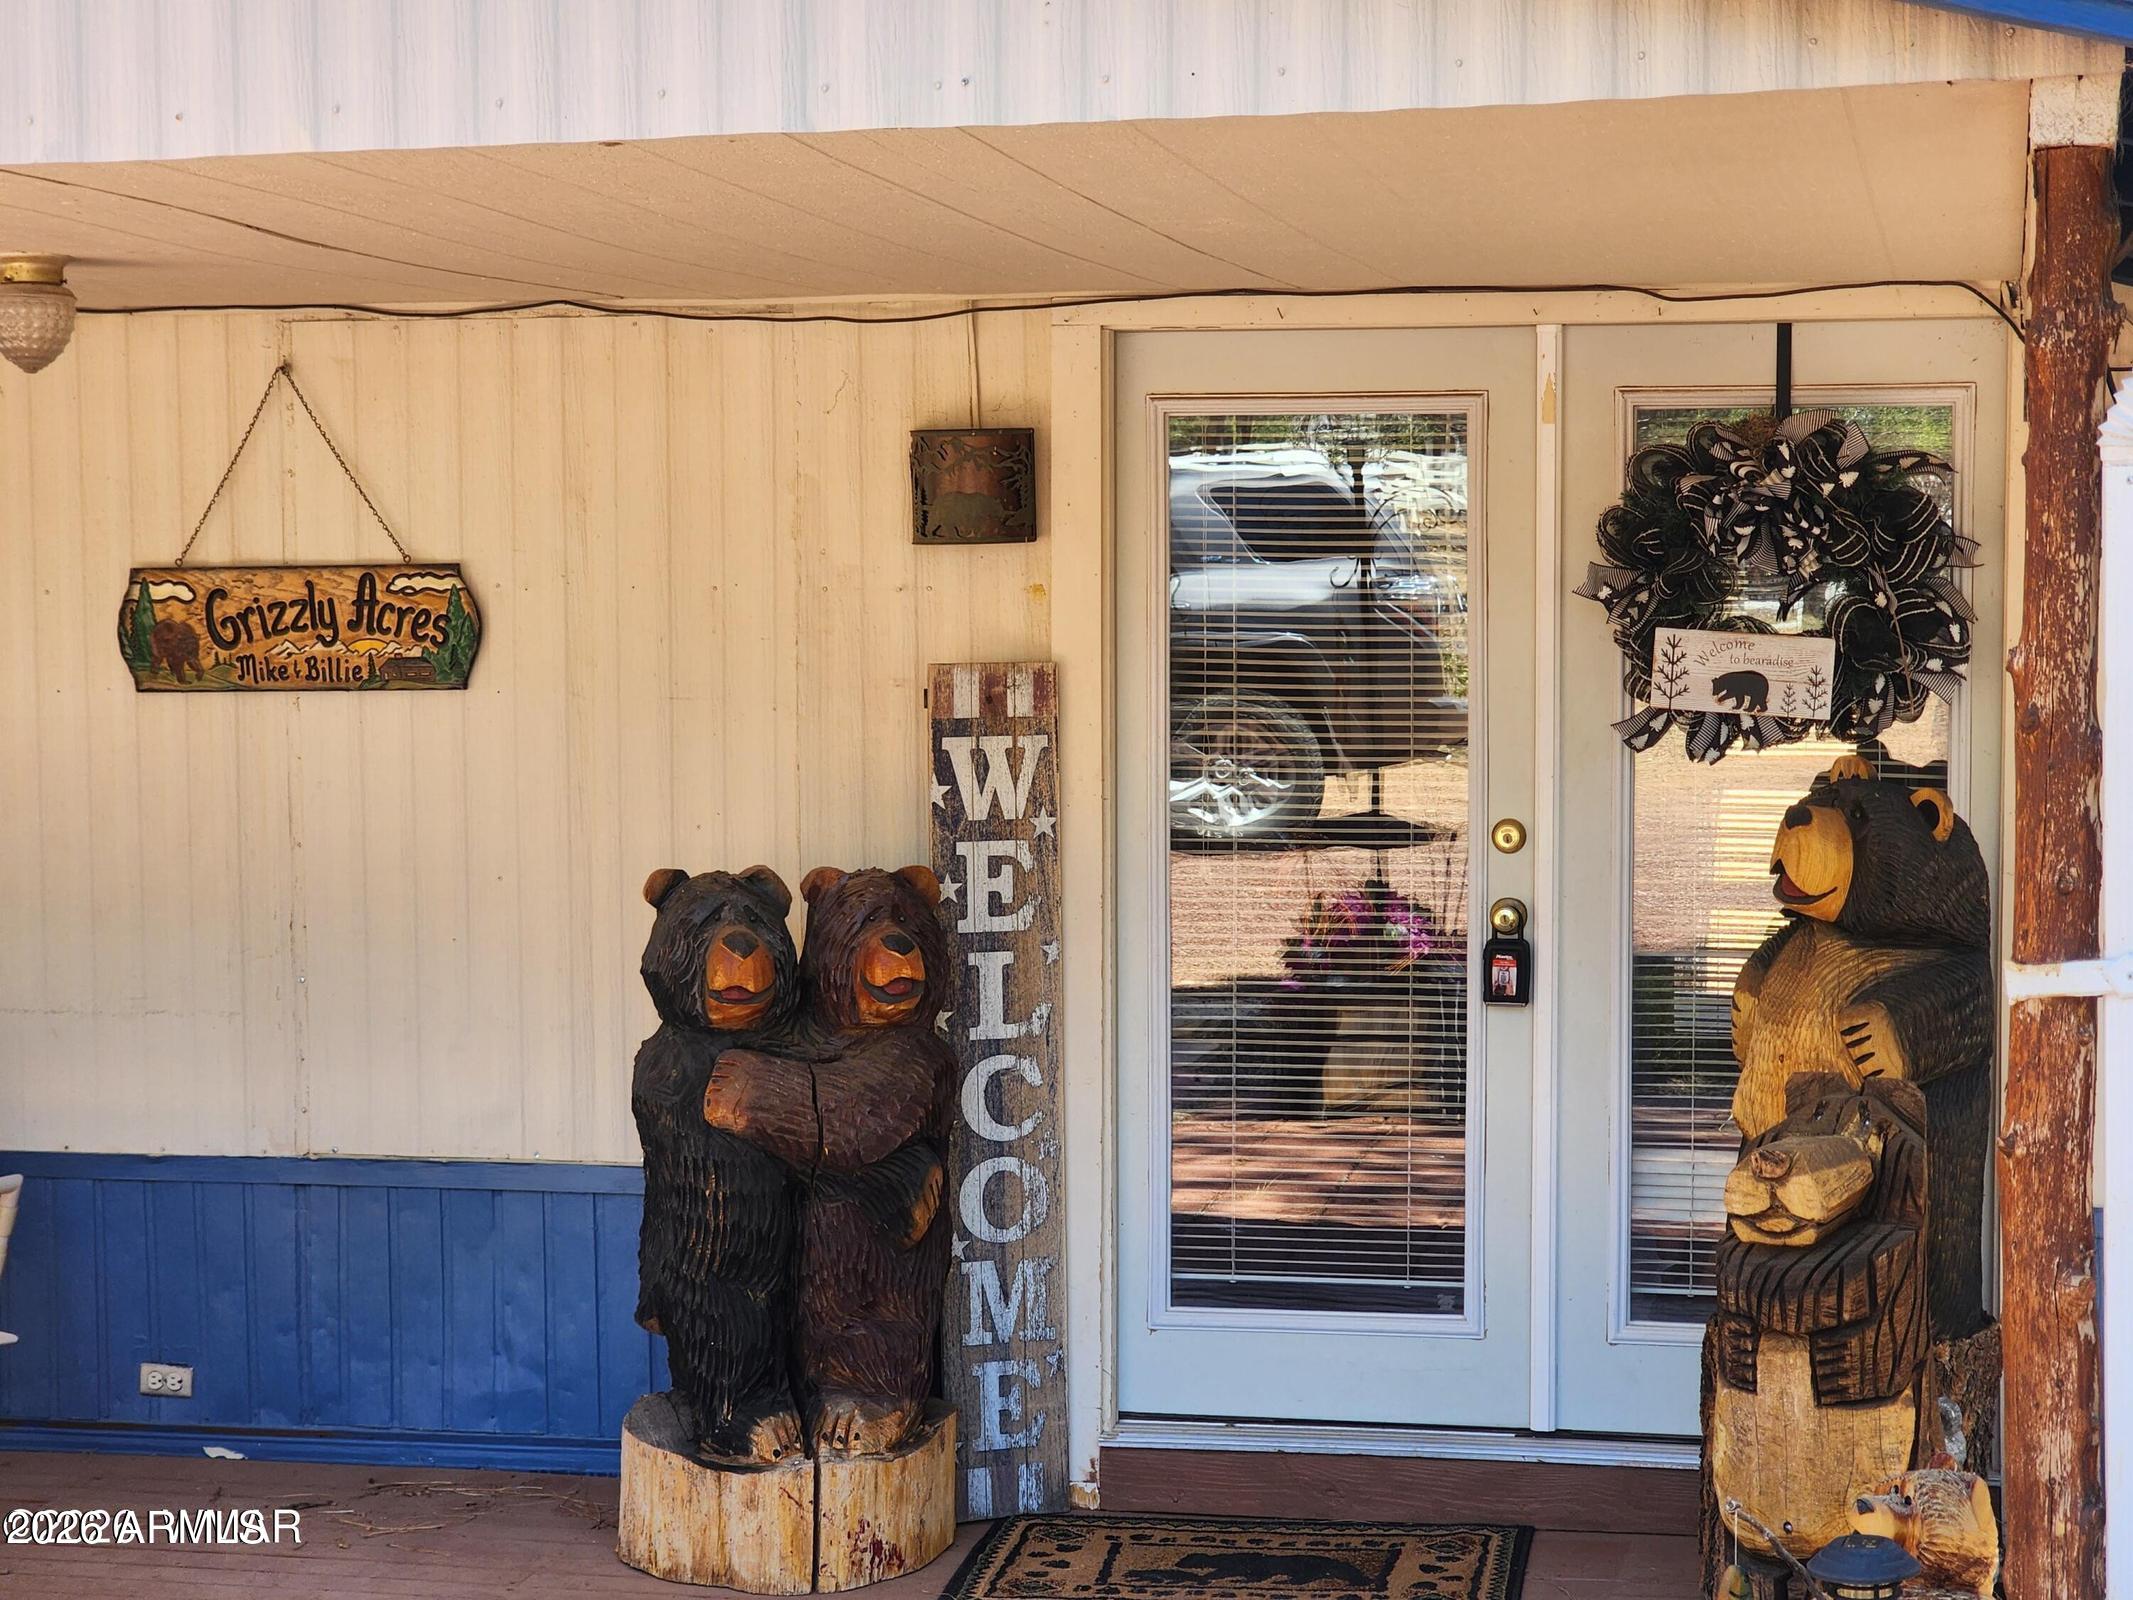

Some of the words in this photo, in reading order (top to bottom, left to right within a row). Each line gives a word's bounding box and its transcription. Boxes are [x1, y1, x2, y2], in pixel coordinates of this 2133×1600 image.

[204, 580, 341, 650] Grizzly
[347, 572, 450, 647] Acres
[1694, 639, 1755, 666] Welcome
[1729, 653, 1741, 665] to
[1743, 652, 1794, 668] bearadise
[237, 655, 290, 682] Mike
[304, 655, 364, 683] Billie
[941, 734, 1057, 1453] WELCOME
